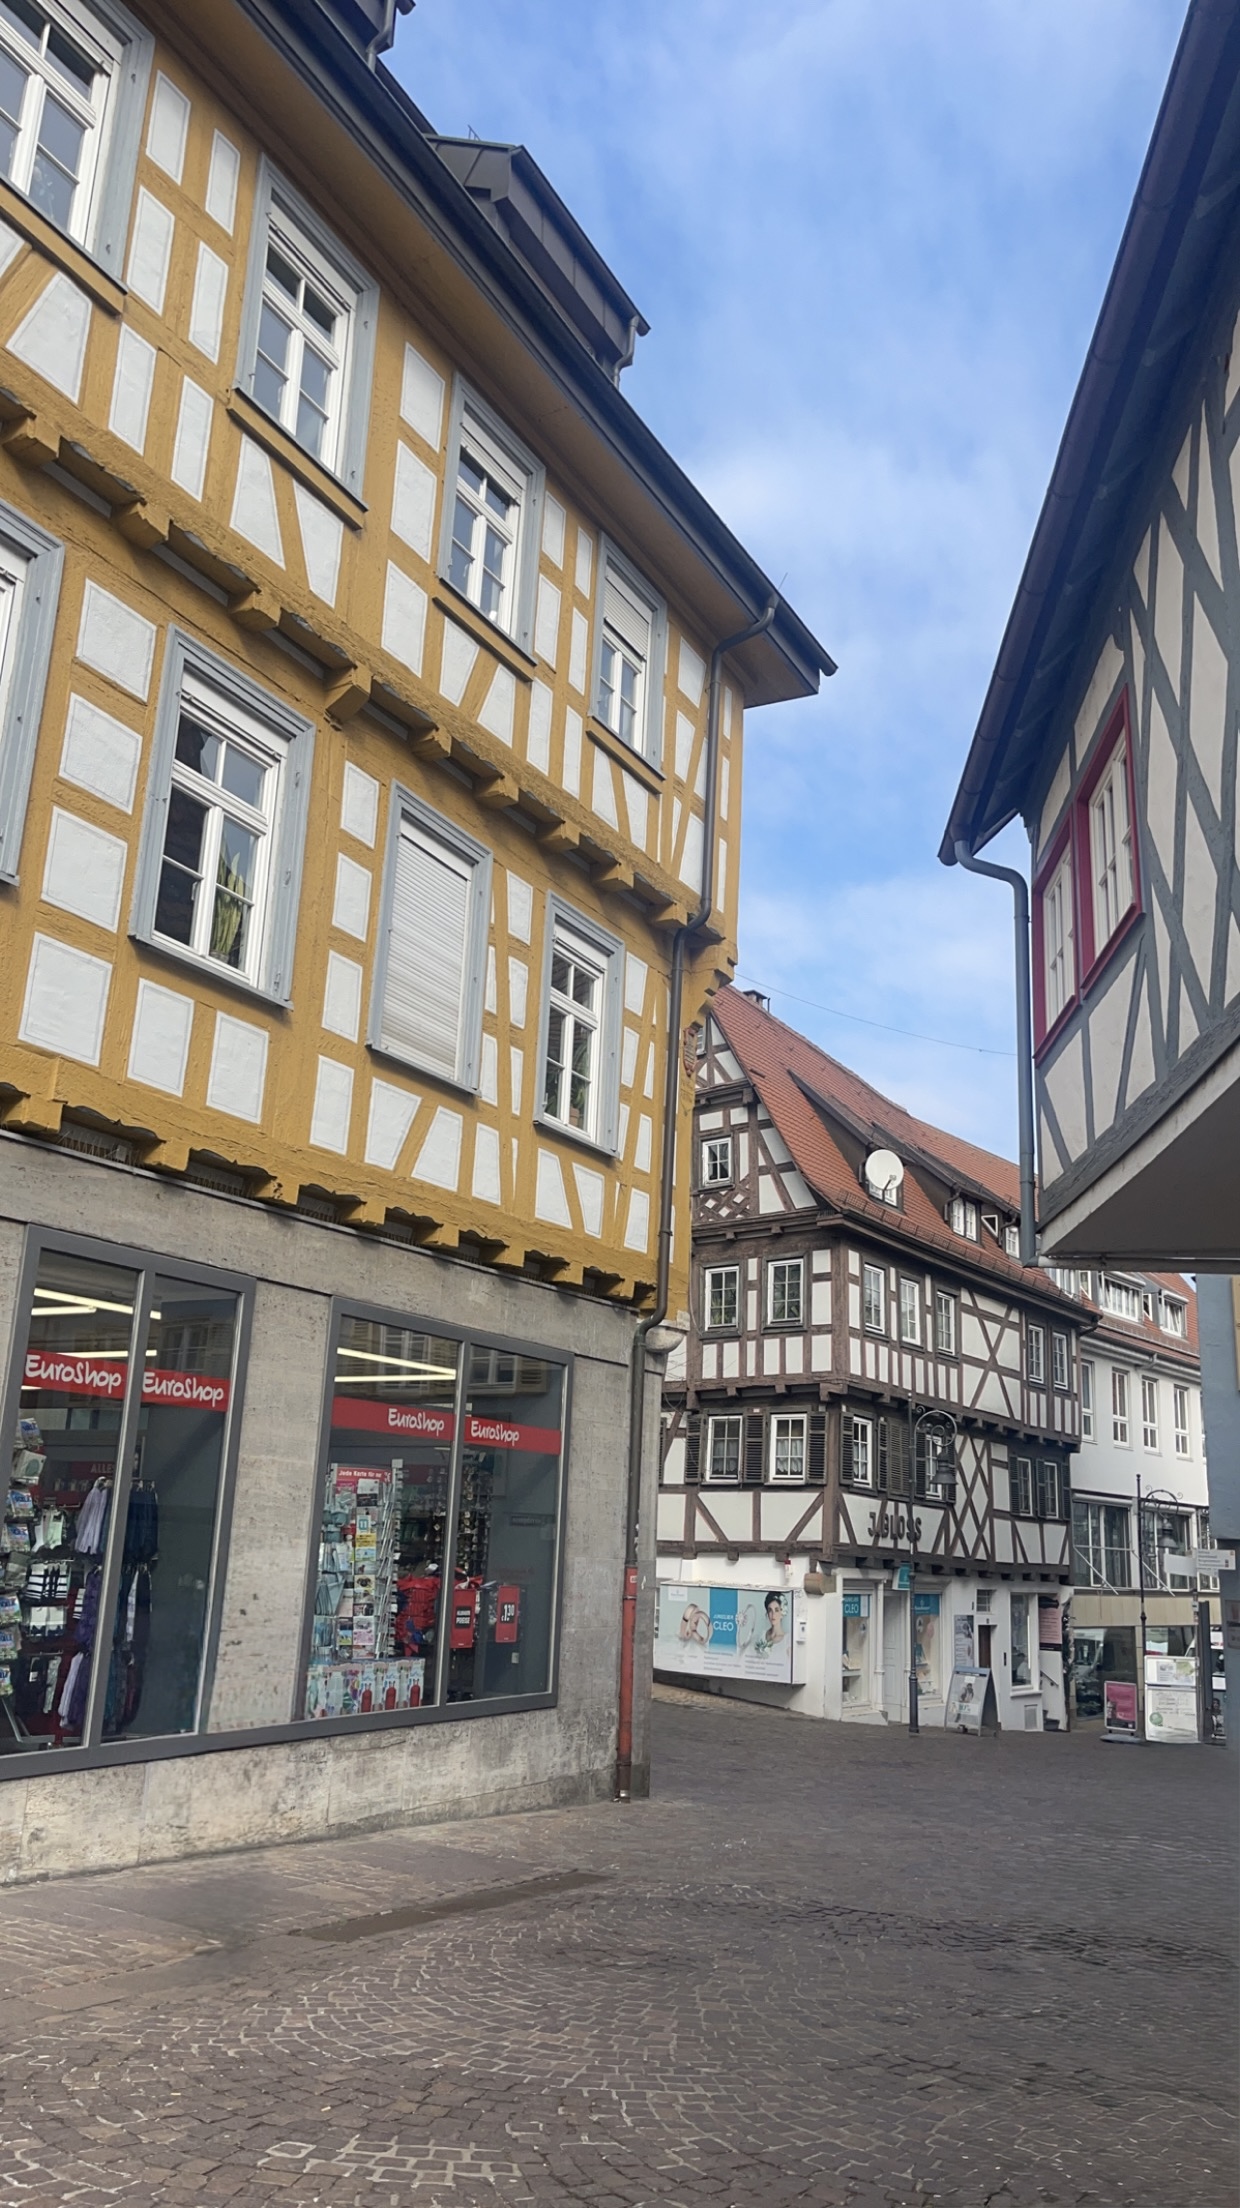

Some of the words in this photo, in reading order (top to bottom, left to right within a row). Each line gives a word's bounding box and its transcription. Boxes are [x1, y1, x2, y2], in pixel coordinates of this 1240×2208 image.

[25, 1354, 122, 1394] EuroShop
[142, 1372, 224, 1408] EuroShop
[388, 1408, 444, 1436] EuroShop
[471, 1420, 519, 1446] EuroShop
[844, 1603, 860, 1614] CLEO
[712, 1621, 734, 1632] CLEO
